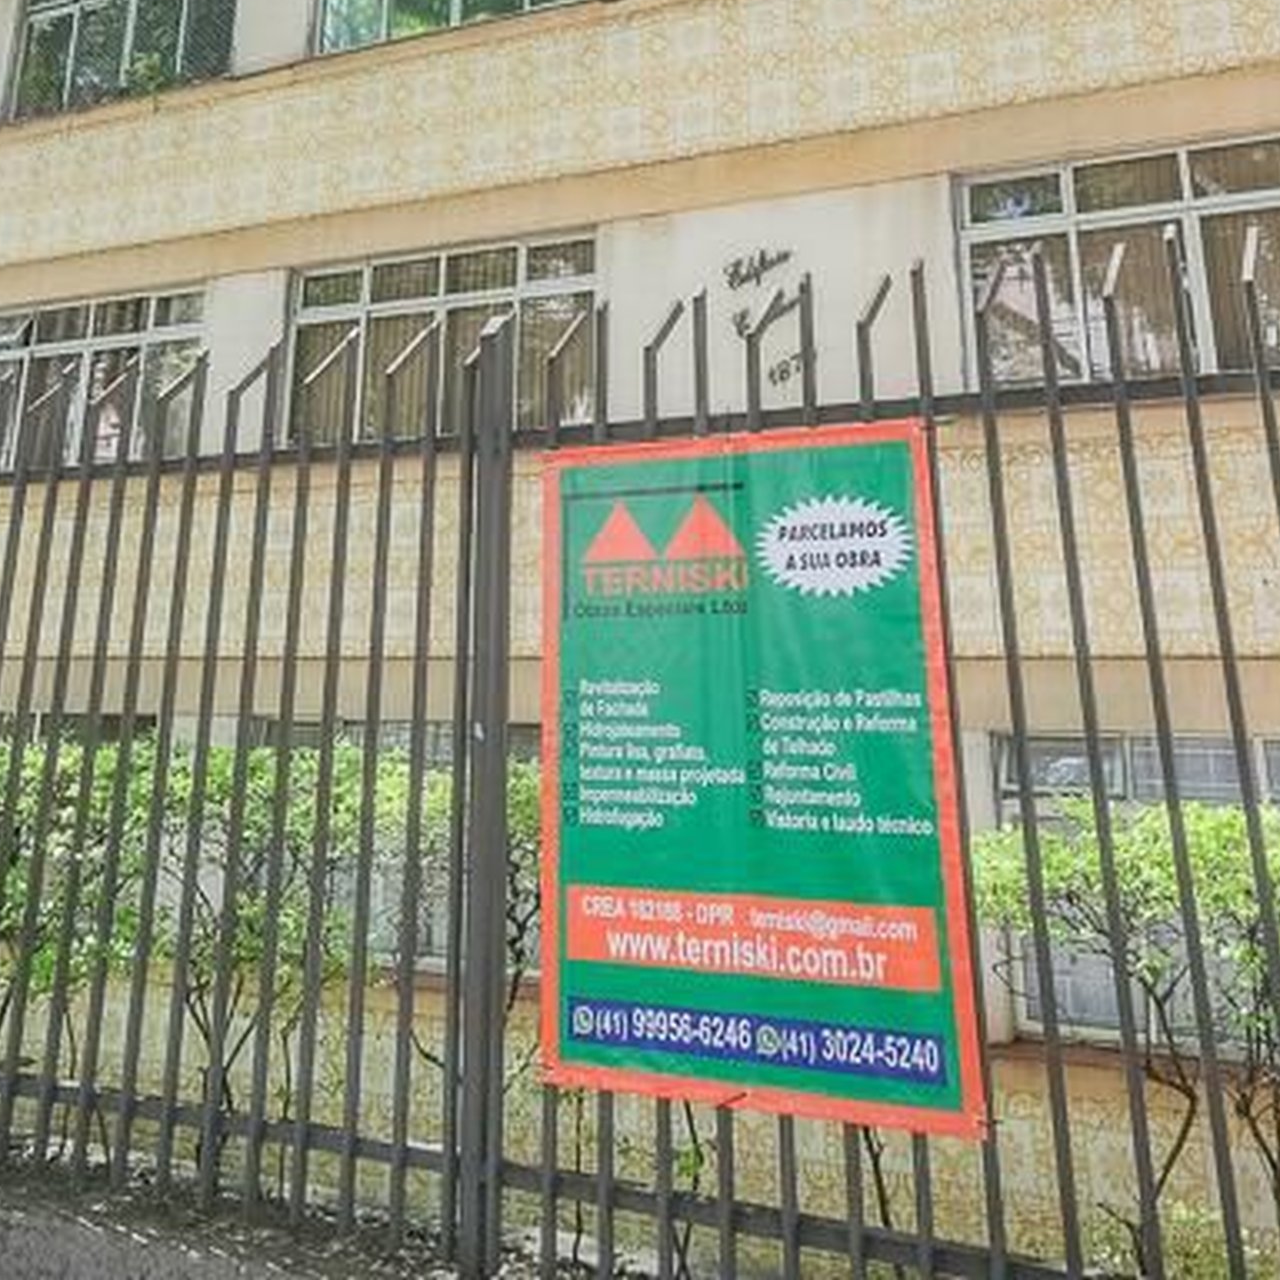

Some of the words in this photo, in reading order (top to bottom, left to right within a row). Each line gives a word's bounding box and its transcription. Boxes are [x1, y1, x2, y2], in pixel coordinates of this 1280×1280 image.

[778, 520, 888, 541] PARCELAMOS
[785, 554, 797, 570] A
[801, 552, 830, 570] SUA
[835, 549, 881, 568] OBRA
[585, 560, 747, 596] TERNISKI
[597, 700, 648, 717] Fachada
[760, 690, 830, 709] Reposição
[833, 691, 852, 706] de
[856, 690, 921, 707] Pastilhas
[760, 713, 840, 734] Construção
[843, 718, 852, 731] e
[855, 714, 917, 732] Reforma
[763, 738, 778, 754] de
[782, 737, 837, 755] Telhado
[636, 769, 677, 782] massa
[680, 766, 746, 786] projetada
[763, 761, 820, 779] Reforma
[823, 763, 856, 780] Civil
[764, 785, 860, 807] Rejuntamento
[580, 807, 664, 830] Hidrofugação
[765, 811, 818, 829] Vistoria
[821, 817, 830, 830] e
[833, 813, 873, 831] laudo
[876, 816, 934, 835] técnico
[582, 895, 625, 918] CREA
[607, 927, 887, 981] www.terniski.com.br
[595, 1008, 628, 1040] (41)
[632, 1007, 752, 1050] 99956-6246
[781, 1030, 817, 1064] (41)
[821, 1029, 939, 1072] 3024-5240
